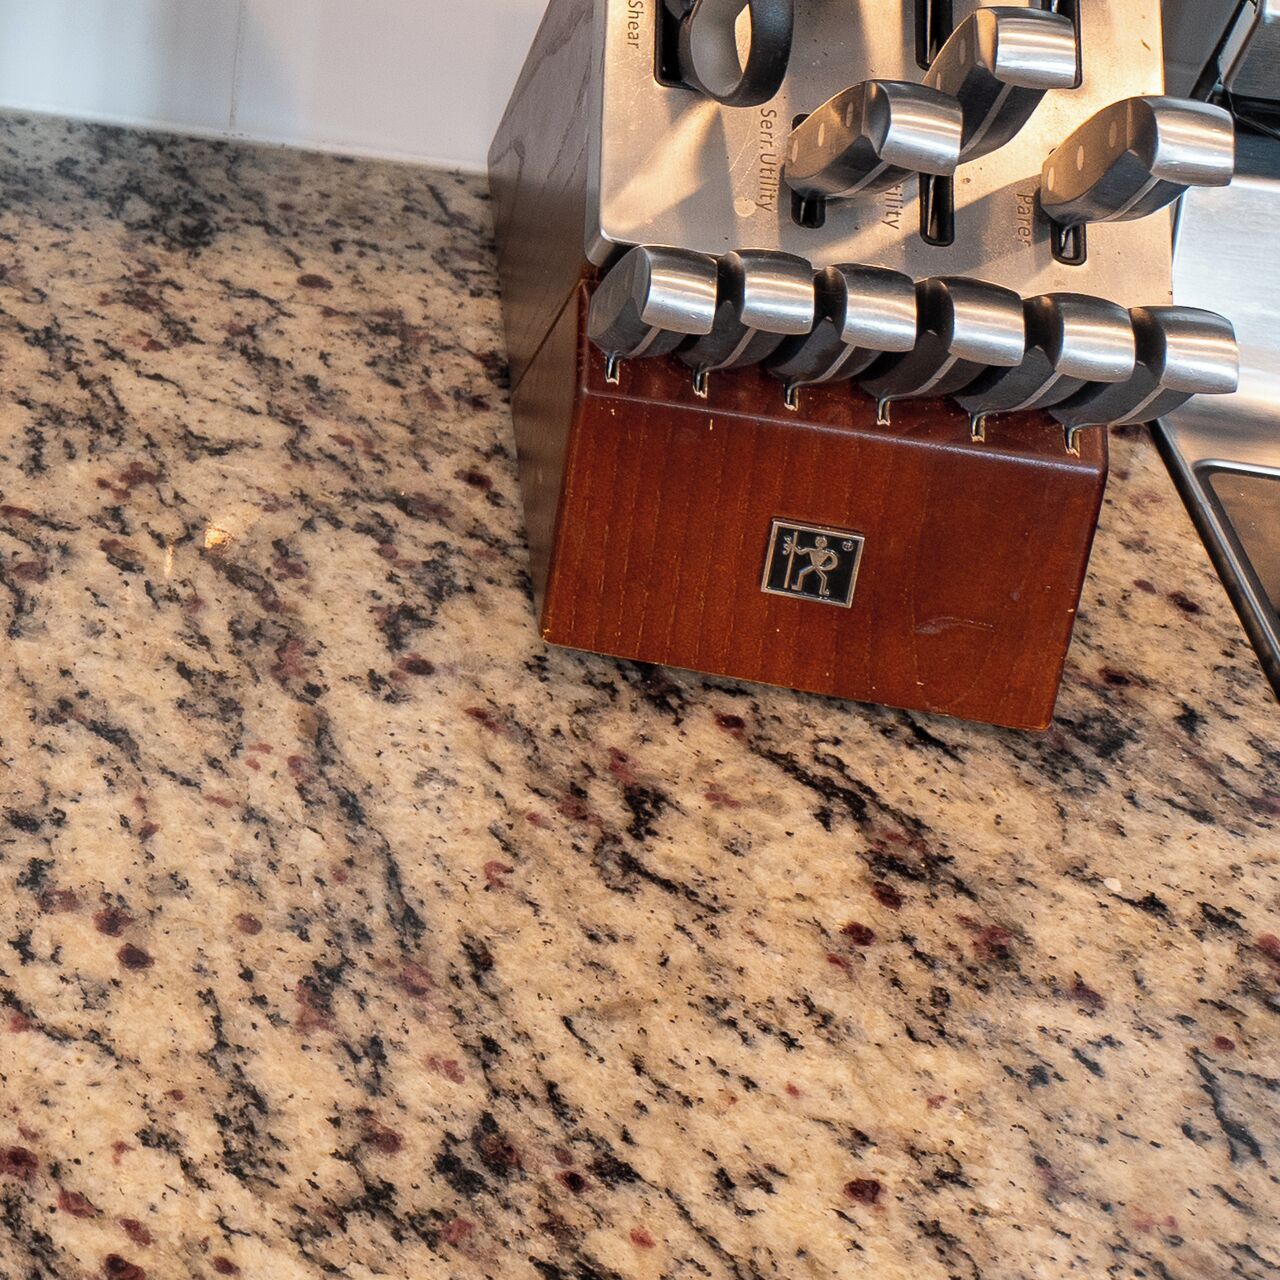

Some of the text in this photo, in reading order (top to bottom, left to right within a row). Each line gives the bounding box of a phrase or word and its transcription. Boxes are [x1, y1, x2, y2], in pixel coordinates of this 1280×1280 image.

[626, 0, 644, 50] Shear
[881, 184, 904, 230] ility
[1016, 193, 1034, 248] Parer
